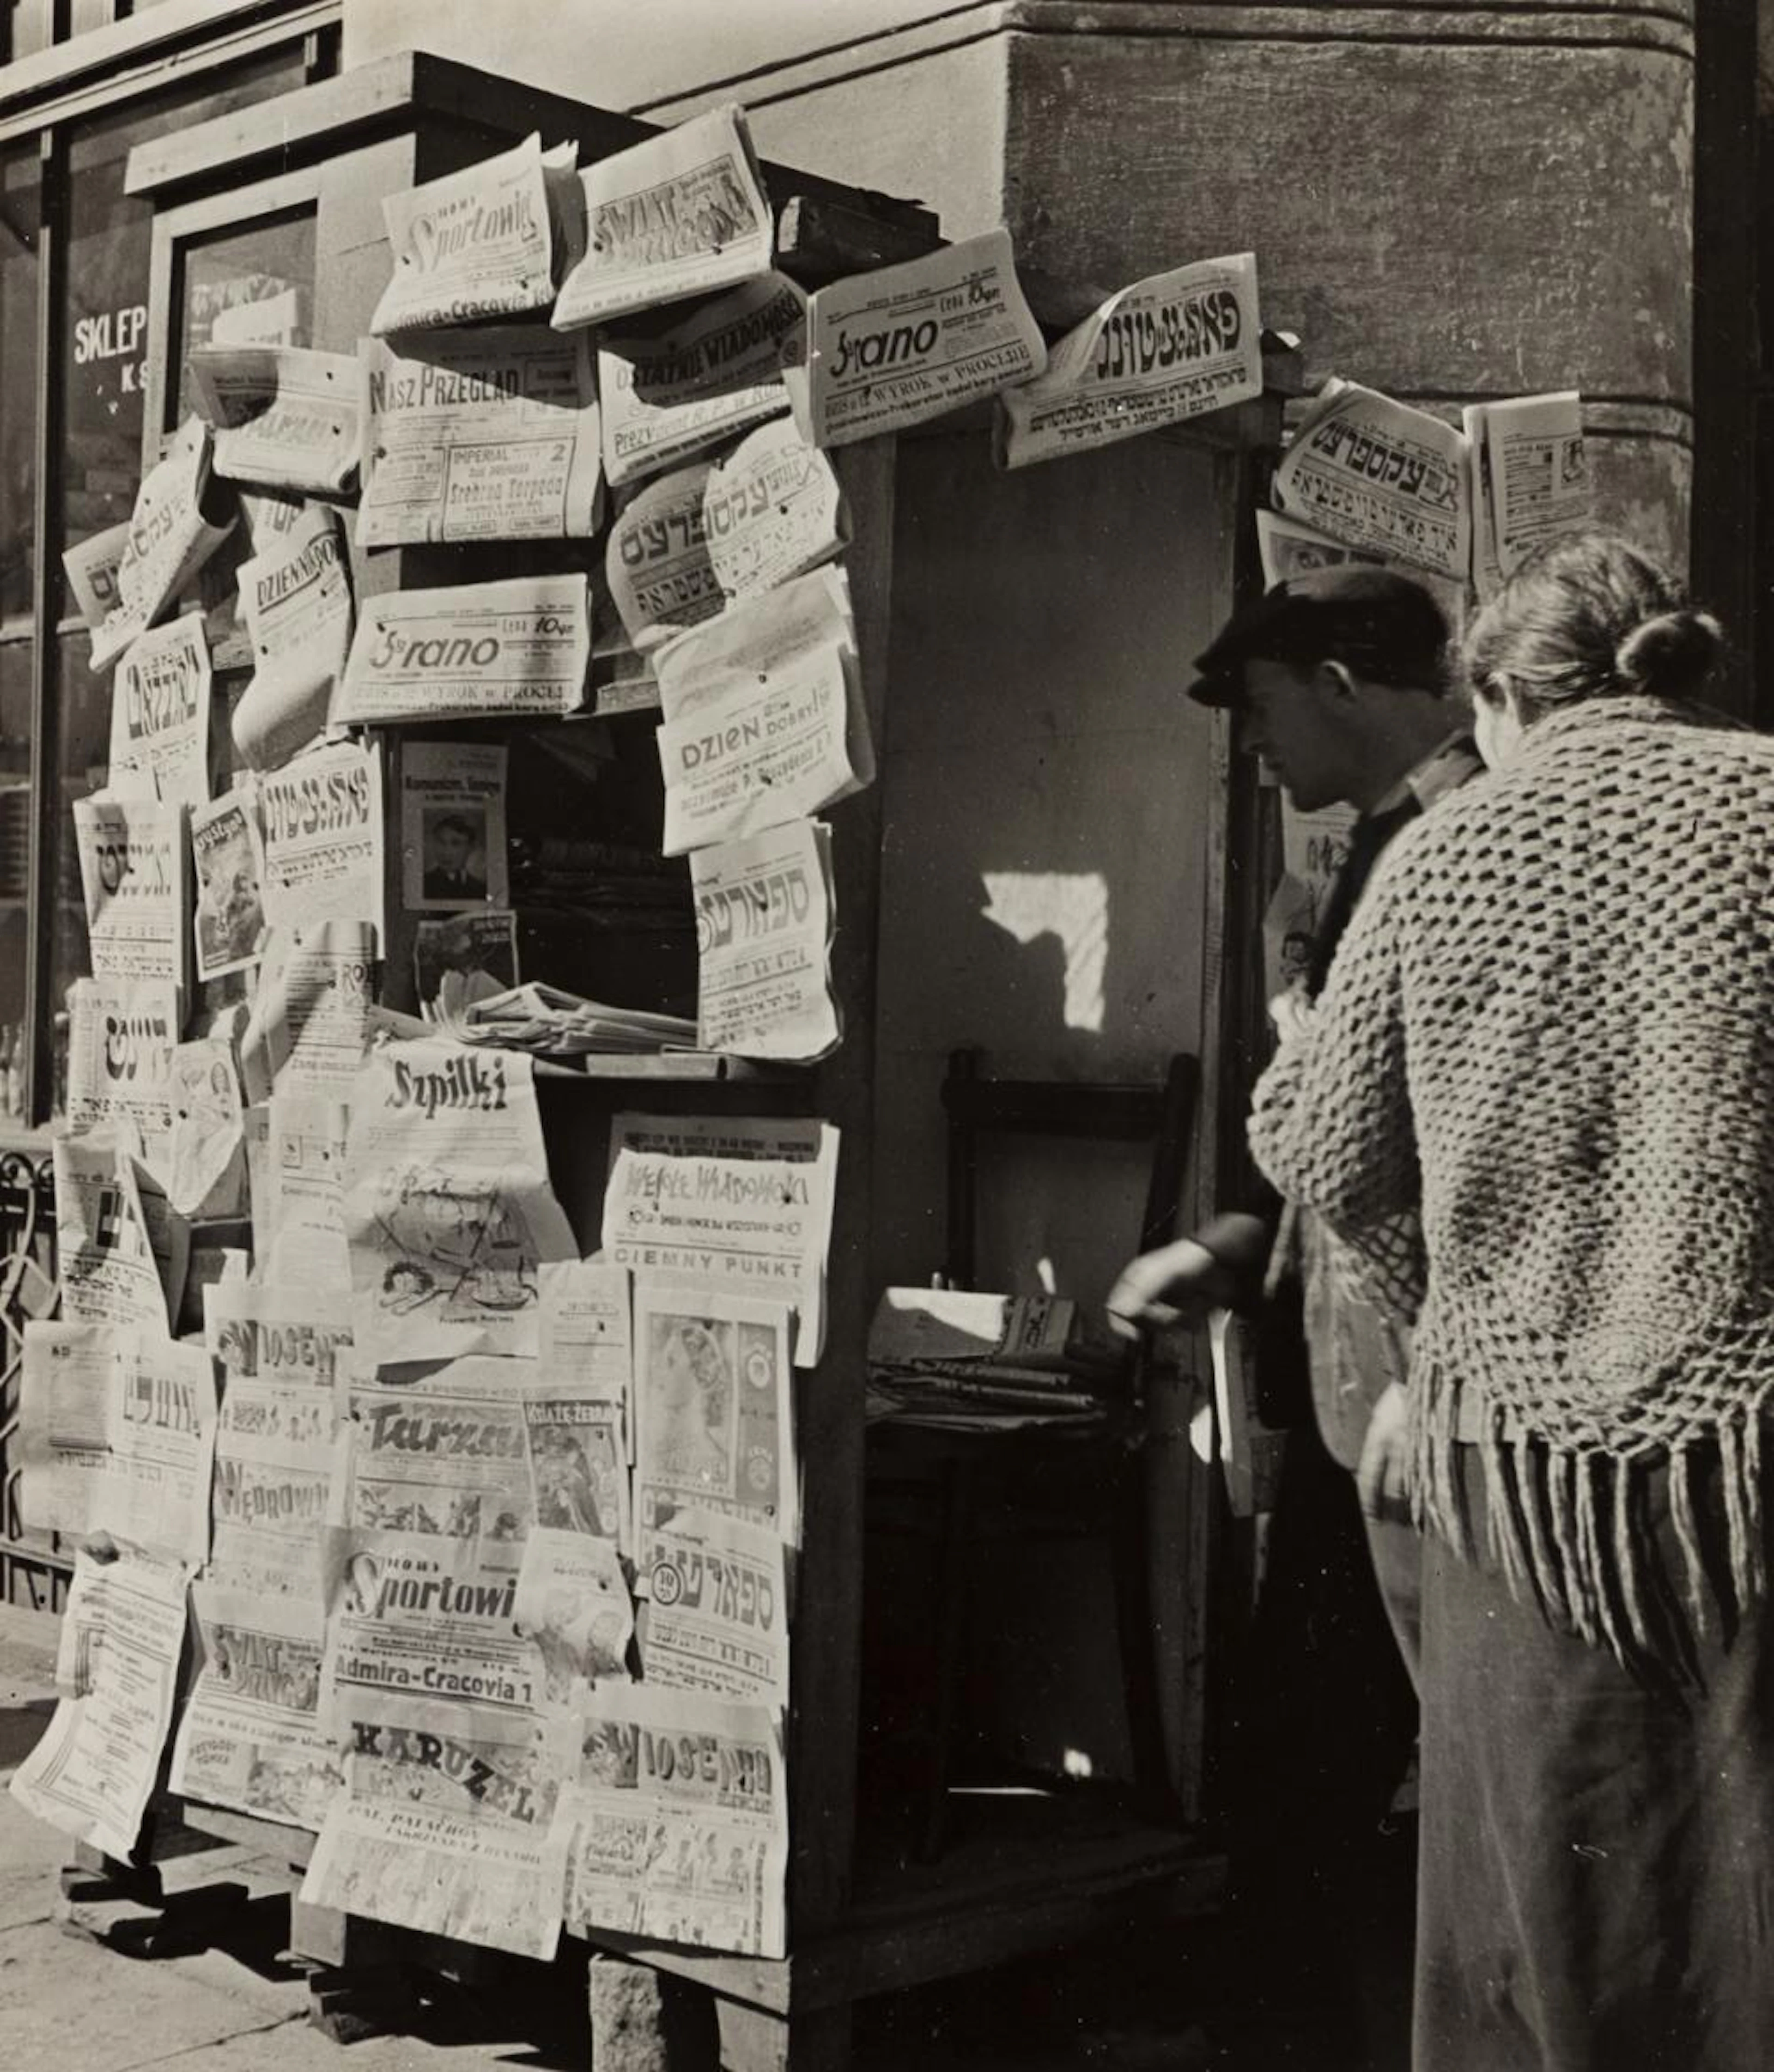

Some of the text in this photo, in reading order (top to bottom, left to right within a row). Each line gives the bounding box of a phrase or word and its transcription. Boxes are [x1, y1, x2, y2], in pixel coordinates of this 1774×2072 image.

[74, 306, 147, 364] SKLEP
[384, 1055, 507, 1119] Szpilki
[614, 1248, 803, 1277] CIEMNY PUNKT
[334, 1654, 515, 1701] Admira-Cracovia
